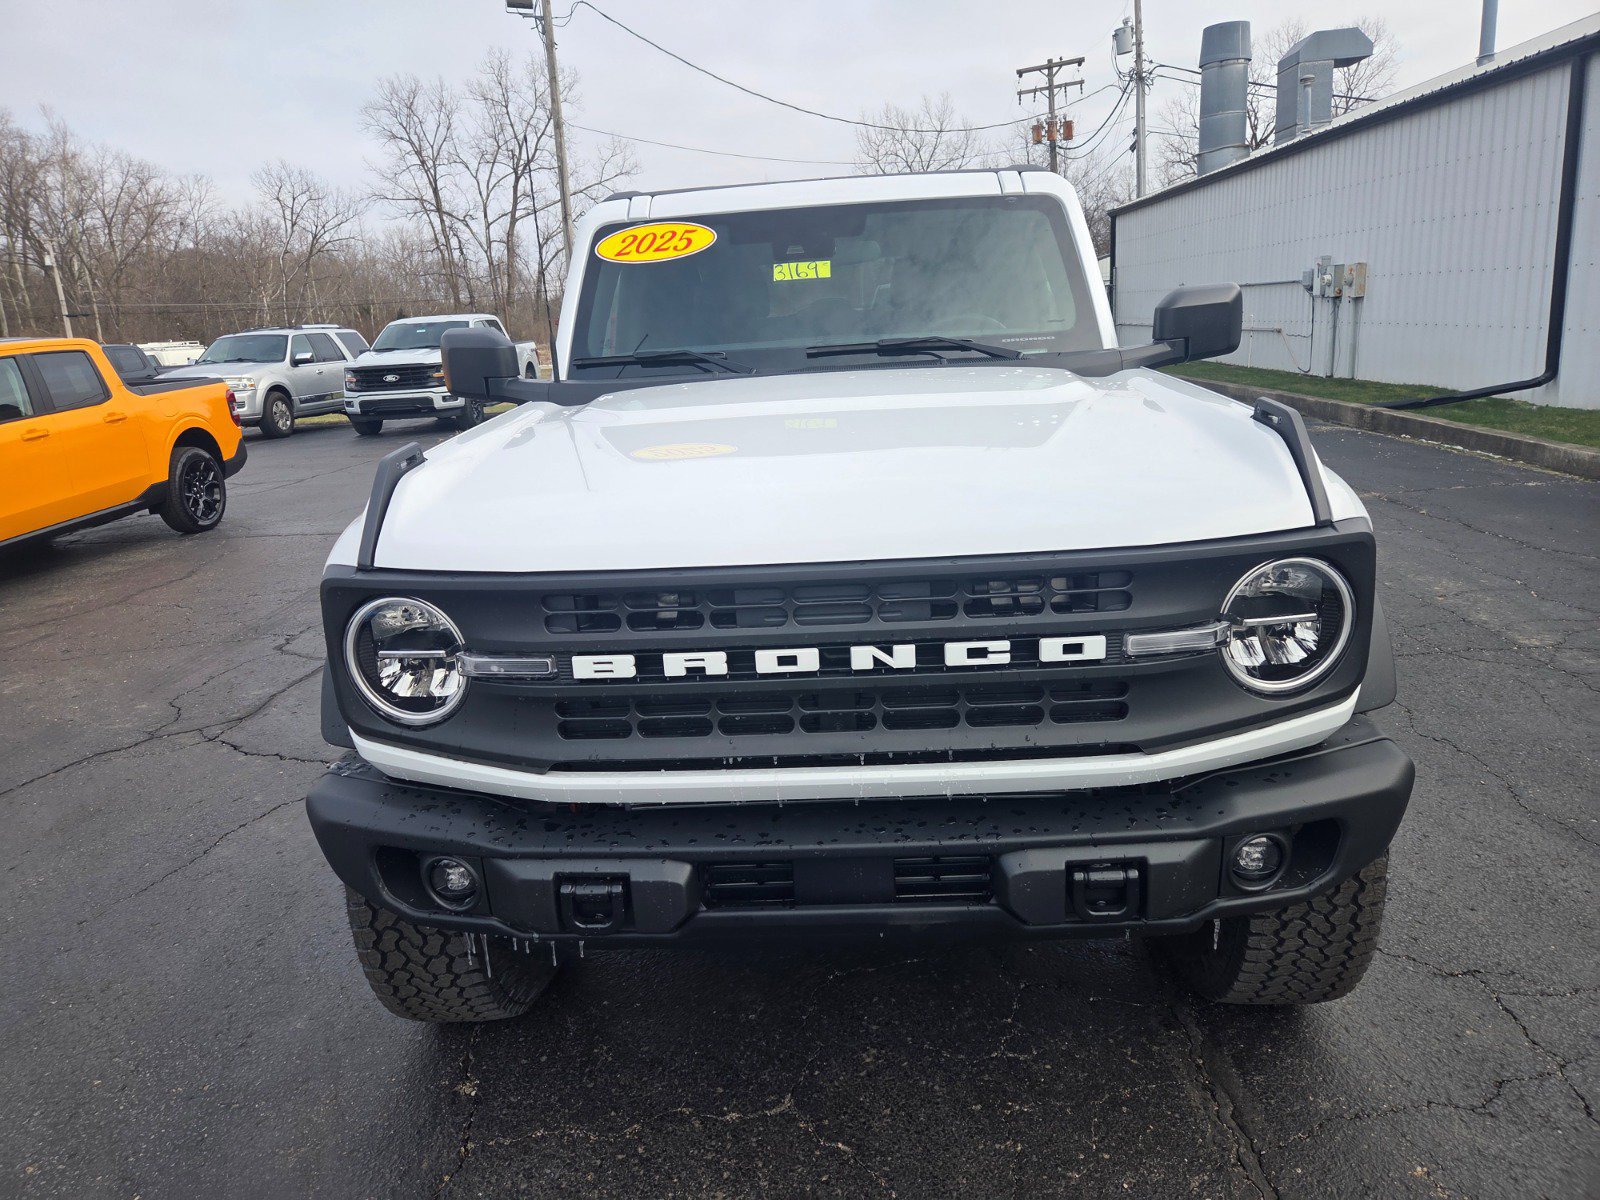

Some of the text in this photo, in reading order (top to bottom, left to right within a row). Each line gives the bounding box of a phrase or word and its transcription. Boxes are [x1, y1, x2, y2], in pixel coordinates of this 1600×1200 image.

[614, 229, 698, 257] 2025
[774, 261, 819, 280] 3169
[571, 635, 1106, 679] BRONCO
